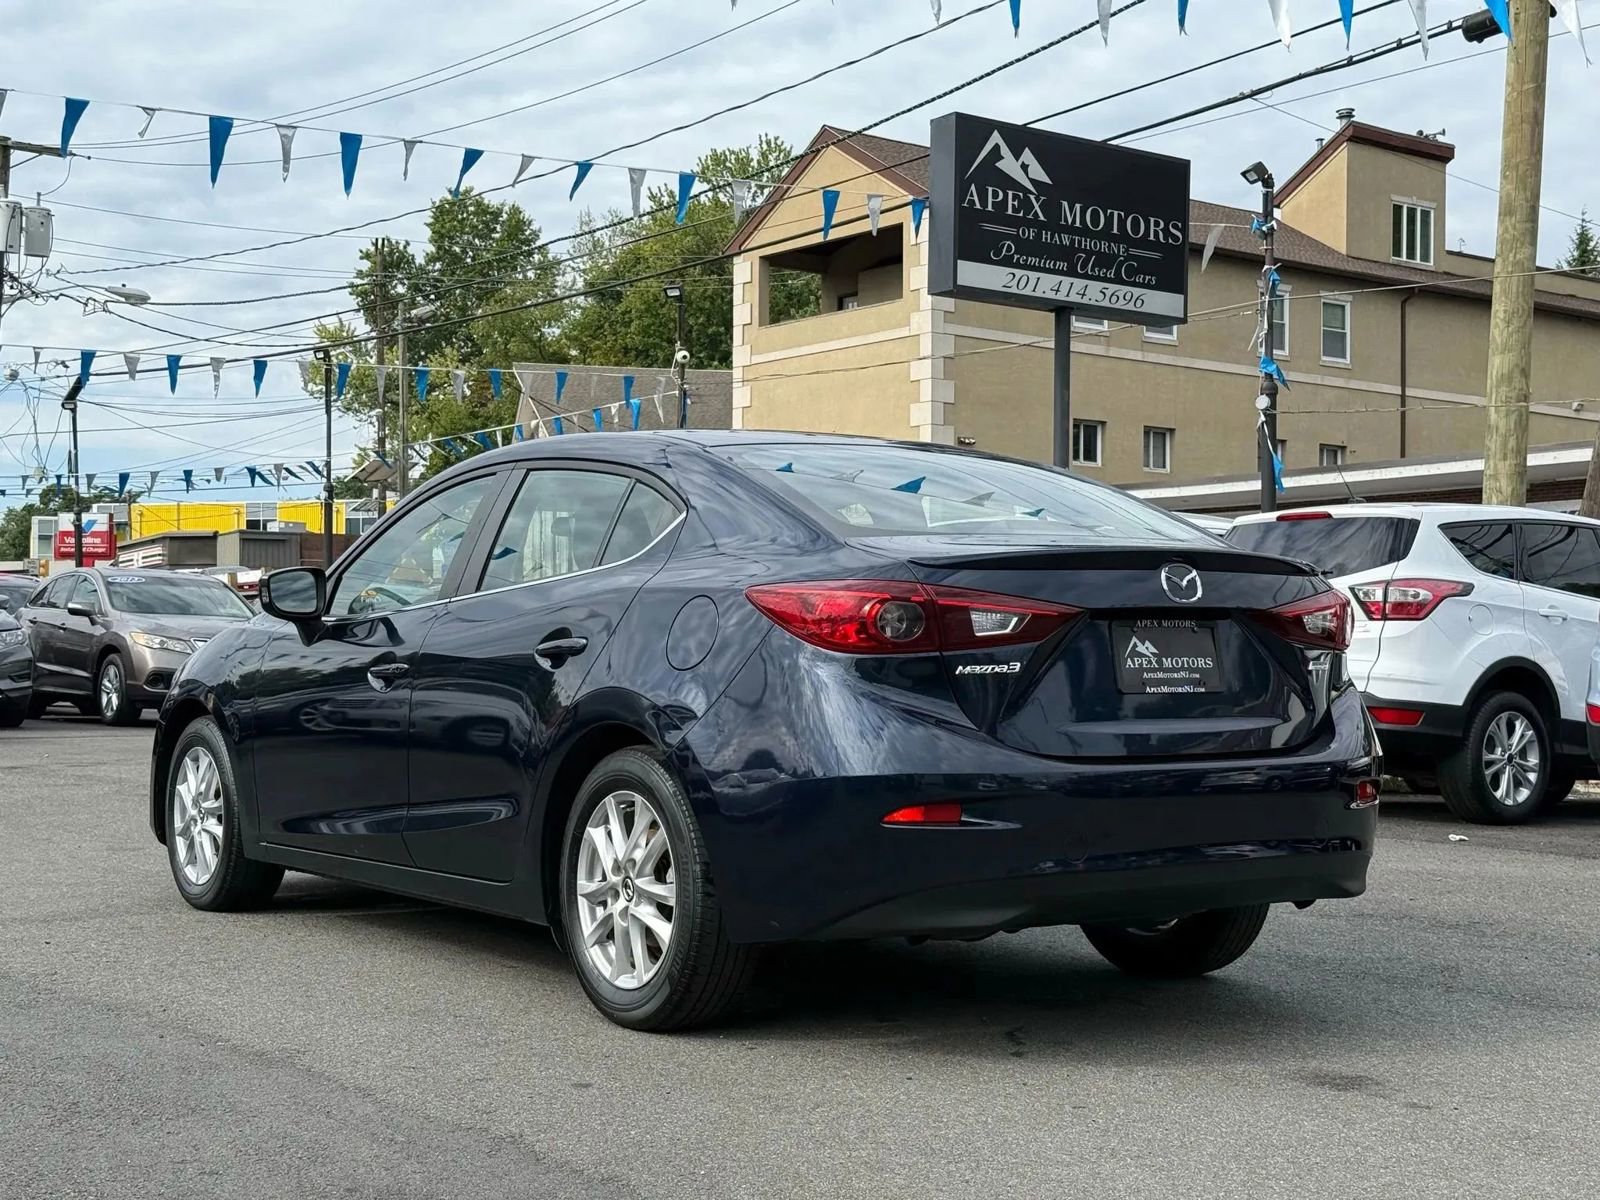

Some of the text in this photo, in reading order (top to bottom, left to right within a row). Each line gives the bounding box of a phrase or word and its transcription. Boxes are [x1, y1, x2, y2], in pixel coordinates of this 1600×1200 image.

[961, 184, 1183, 246] APEX MOTORS
[1019, 226, 1128, 256] OF HAWTHORNE
[990, 240, 1157, 286] Premium Used Cars
[1001, 272, 1146, 309] 201.414.5696
[64, 536, 102, 544] Vaoline
[1135, 619, 1196, 628] APEX MOTORS
[1126, 657, 1213, 668] APEX MOTORS
